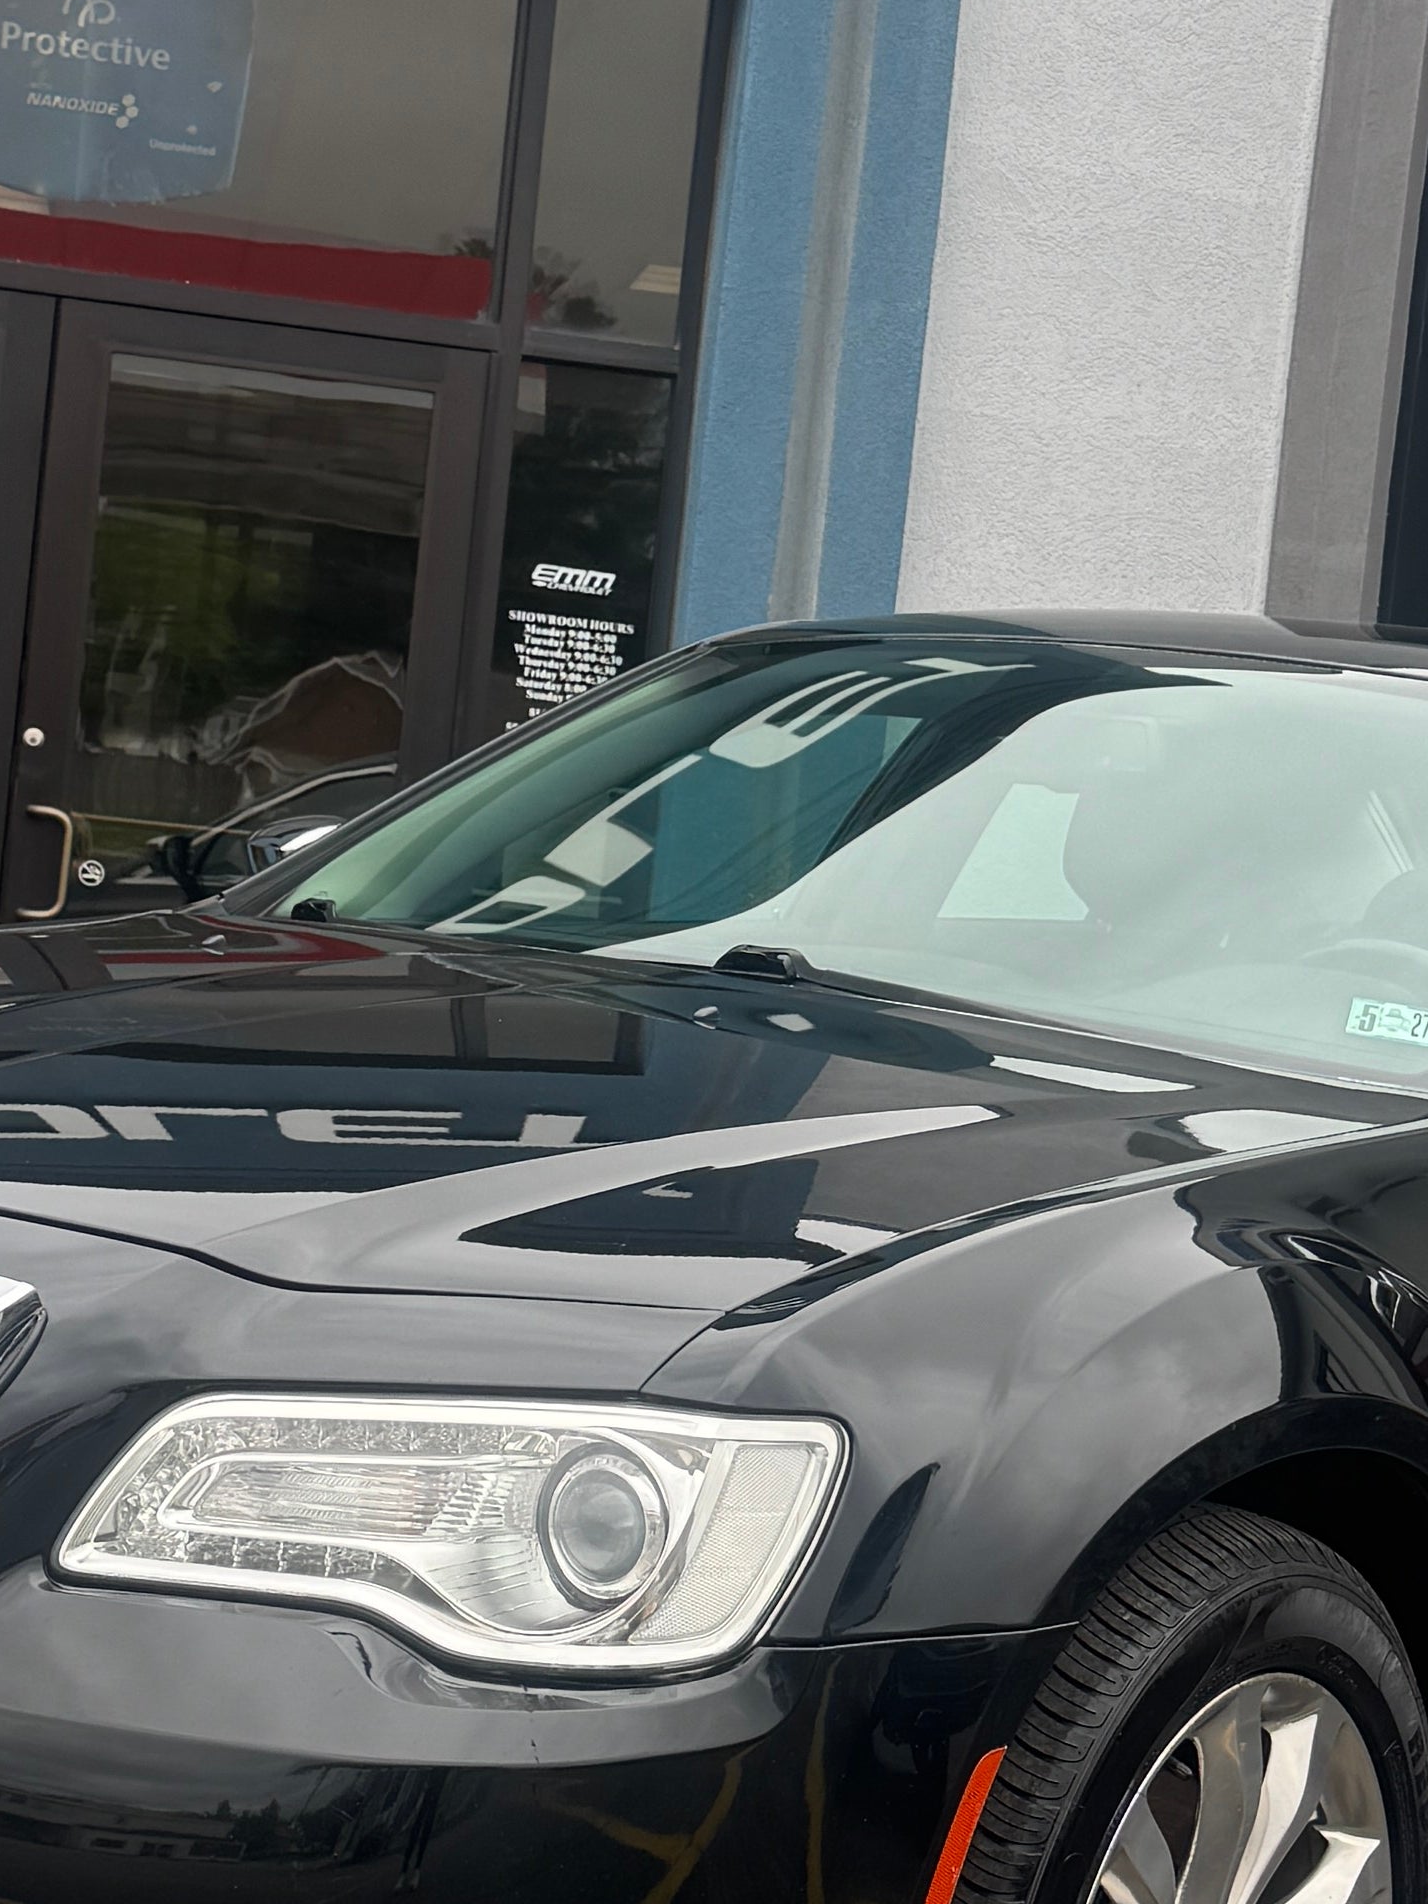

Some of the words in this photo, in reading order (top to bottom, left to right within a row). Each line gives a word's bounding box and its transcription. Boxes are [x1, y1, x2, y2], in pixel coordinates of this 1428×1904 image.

[0, 21, 171, 70] Protective
[27, 92, 119, 115] NANOXIDE
[149, 138, 216, 156] Unprotected
[508, 610, 588, 629] SHOWROOM
[590, 619, 635, 635] HOURS
[524, 624, 566, 640] Monday
[524, 634, 564, 650] Tuesday
[514, 643, 572, 661] Wednesday
[518, 655, 565, 672] Thursday
[524, 667, 557, 682] Friday
[516, 677, 563, 694] Saturday
[526, 689, 564, 704] Sunday
